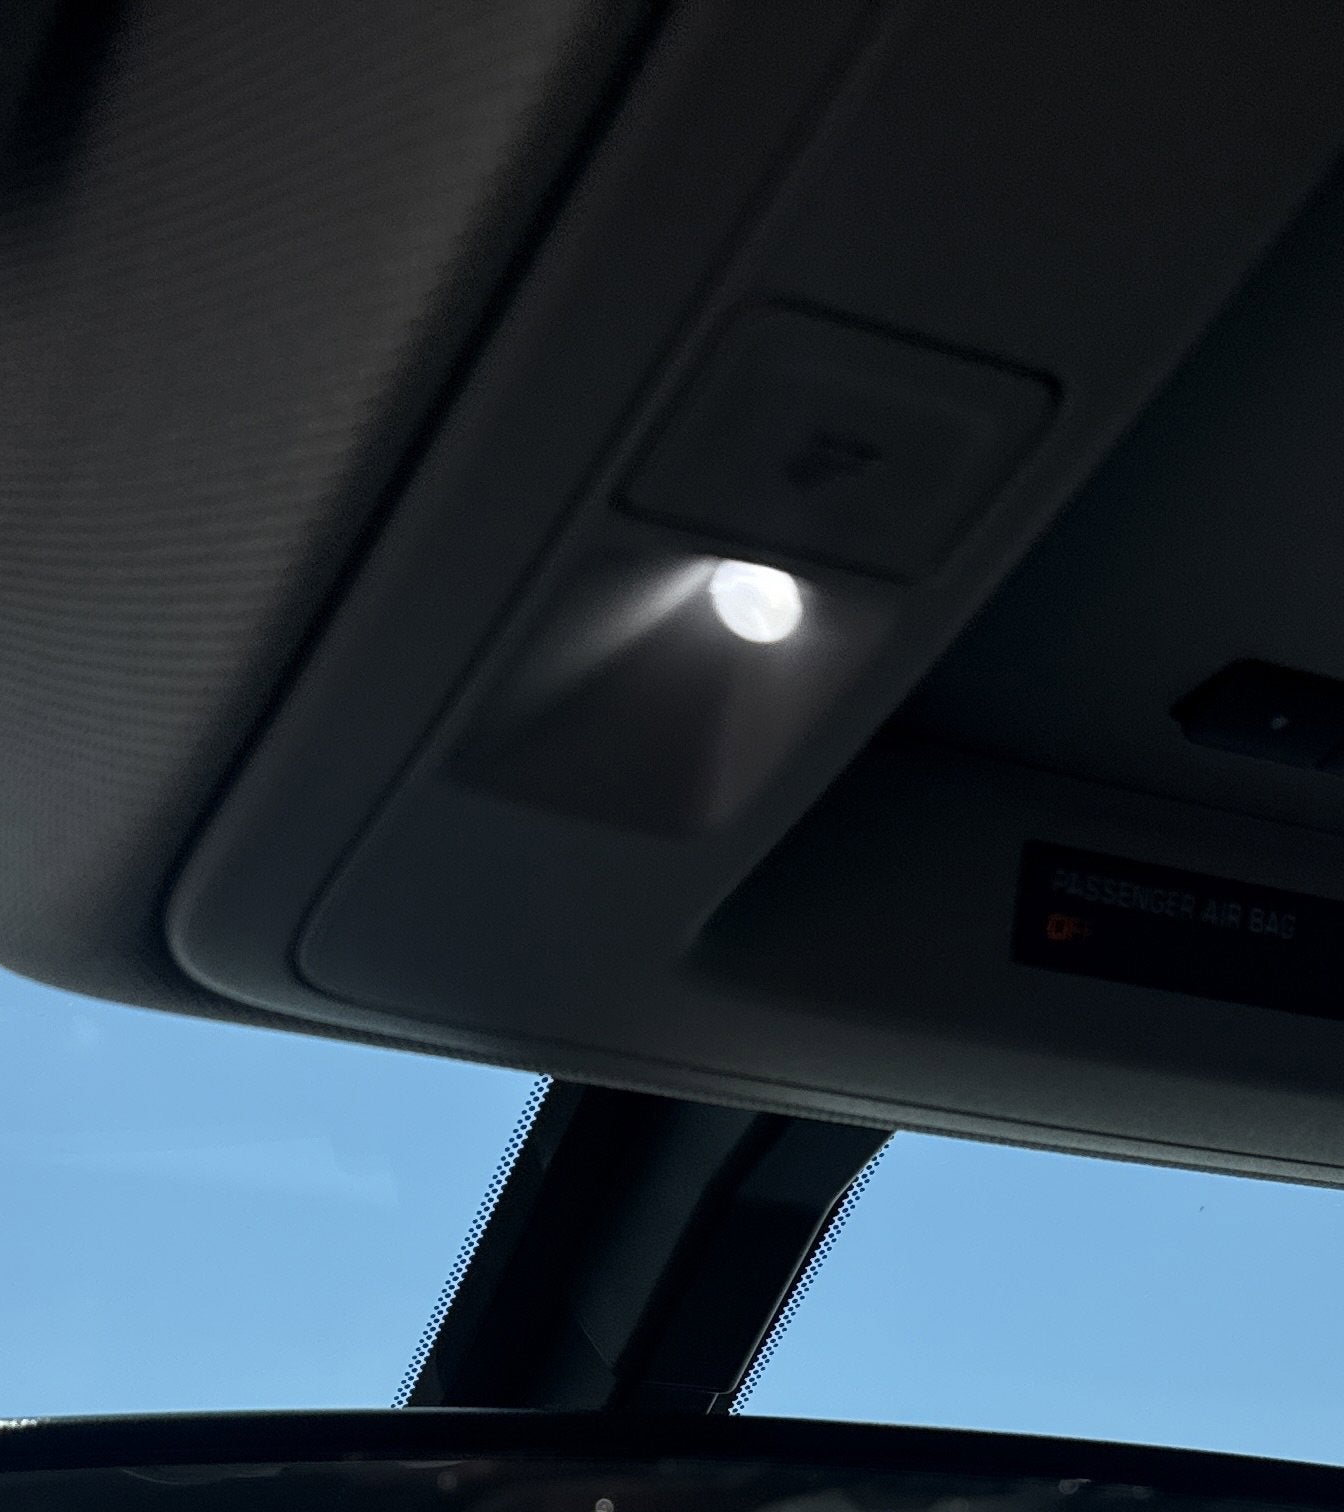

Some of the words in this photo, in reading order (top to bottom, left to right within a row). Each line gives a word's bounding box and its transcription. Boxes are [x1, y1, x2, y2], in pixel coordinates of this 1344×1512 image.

[1052, 867, 1197, 920] PASSENGER
[1201, 897, 1243, 930] AIR
[1249, 907, 1297, 940] BAG
